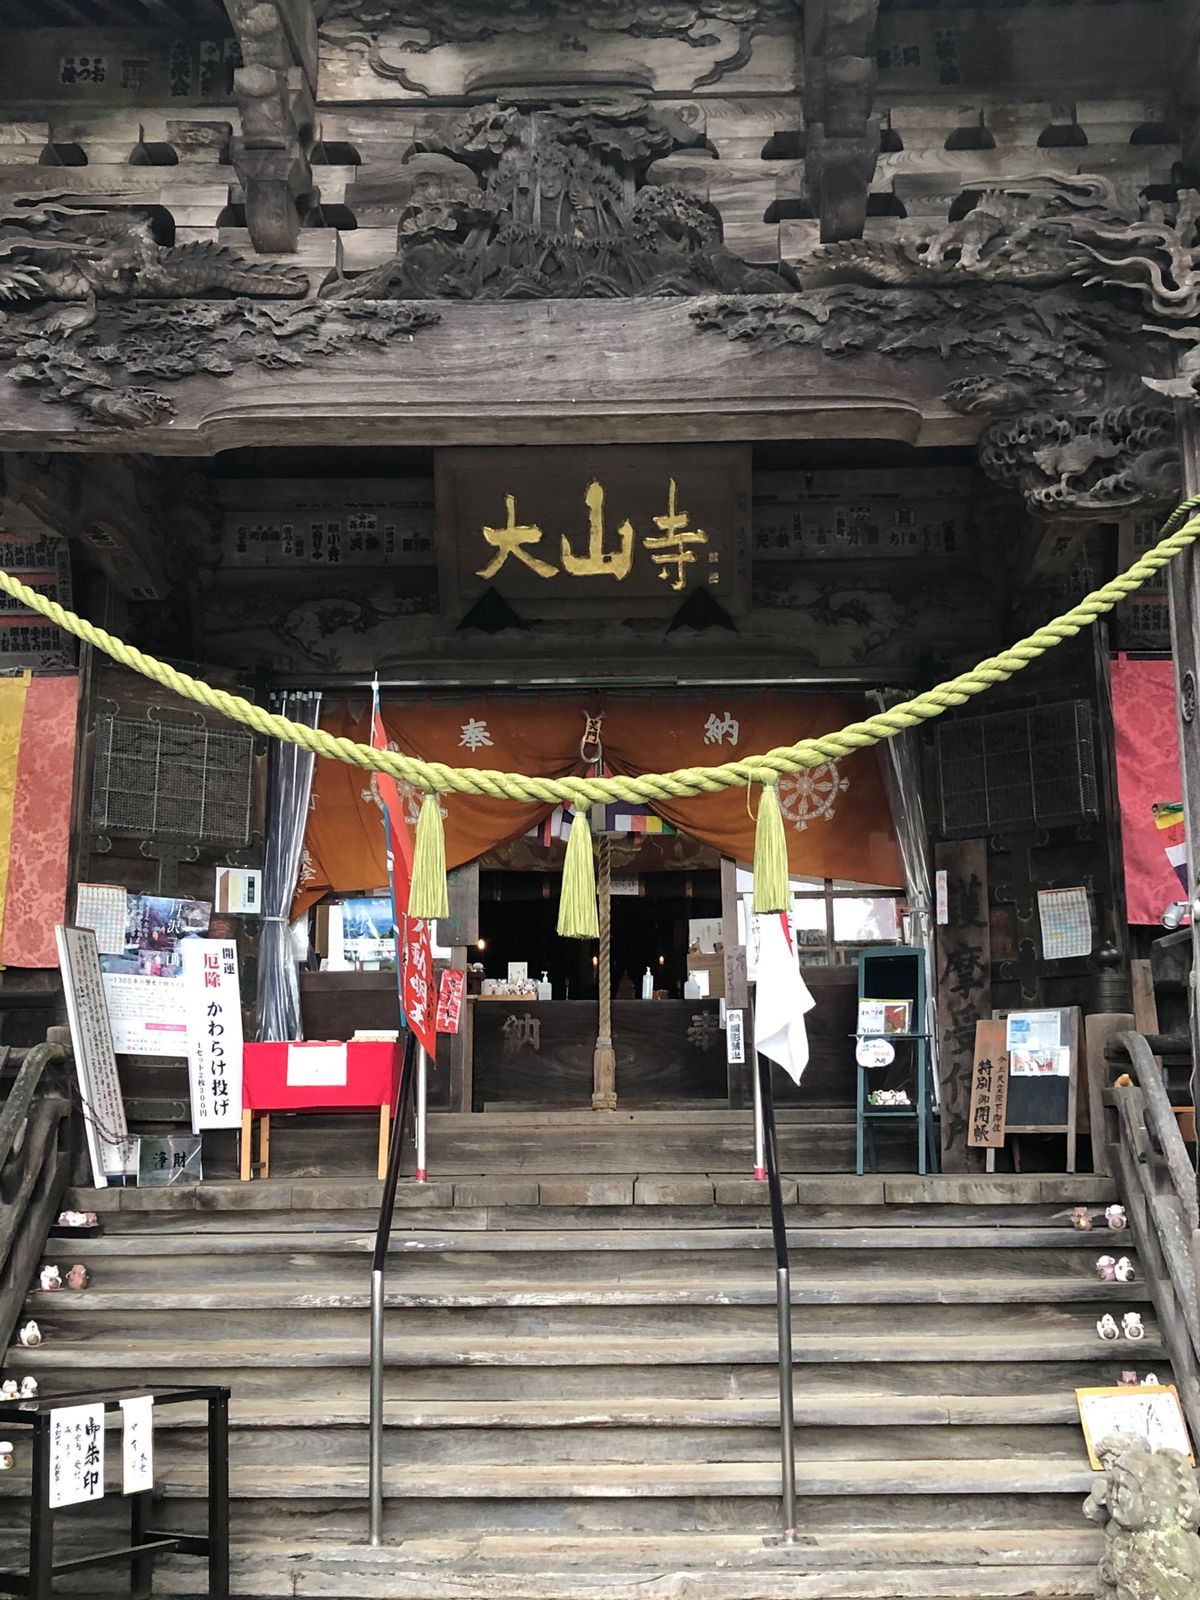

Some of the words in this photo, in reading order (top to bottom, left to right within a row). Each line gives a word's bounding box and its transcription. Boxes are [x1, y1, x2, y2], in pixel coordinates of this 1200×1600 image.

[475, 478, 710, 591] 大山寺
[458, 718, 494, 752] 奉
[585, 719, 599, 742] 笑門
[703, 712, 740, 746] 納
[203, 952, 221, 988] 厄除
[222, 947, 235, 975] 開運
[207, 1000, 230, 1117] かわらけ投げ
[973, 1058, 993, 1143] 特別御開帳
[153, 1151, 188, 1169] 浄財
[83, 1416, 101, 1496] 御朱印
